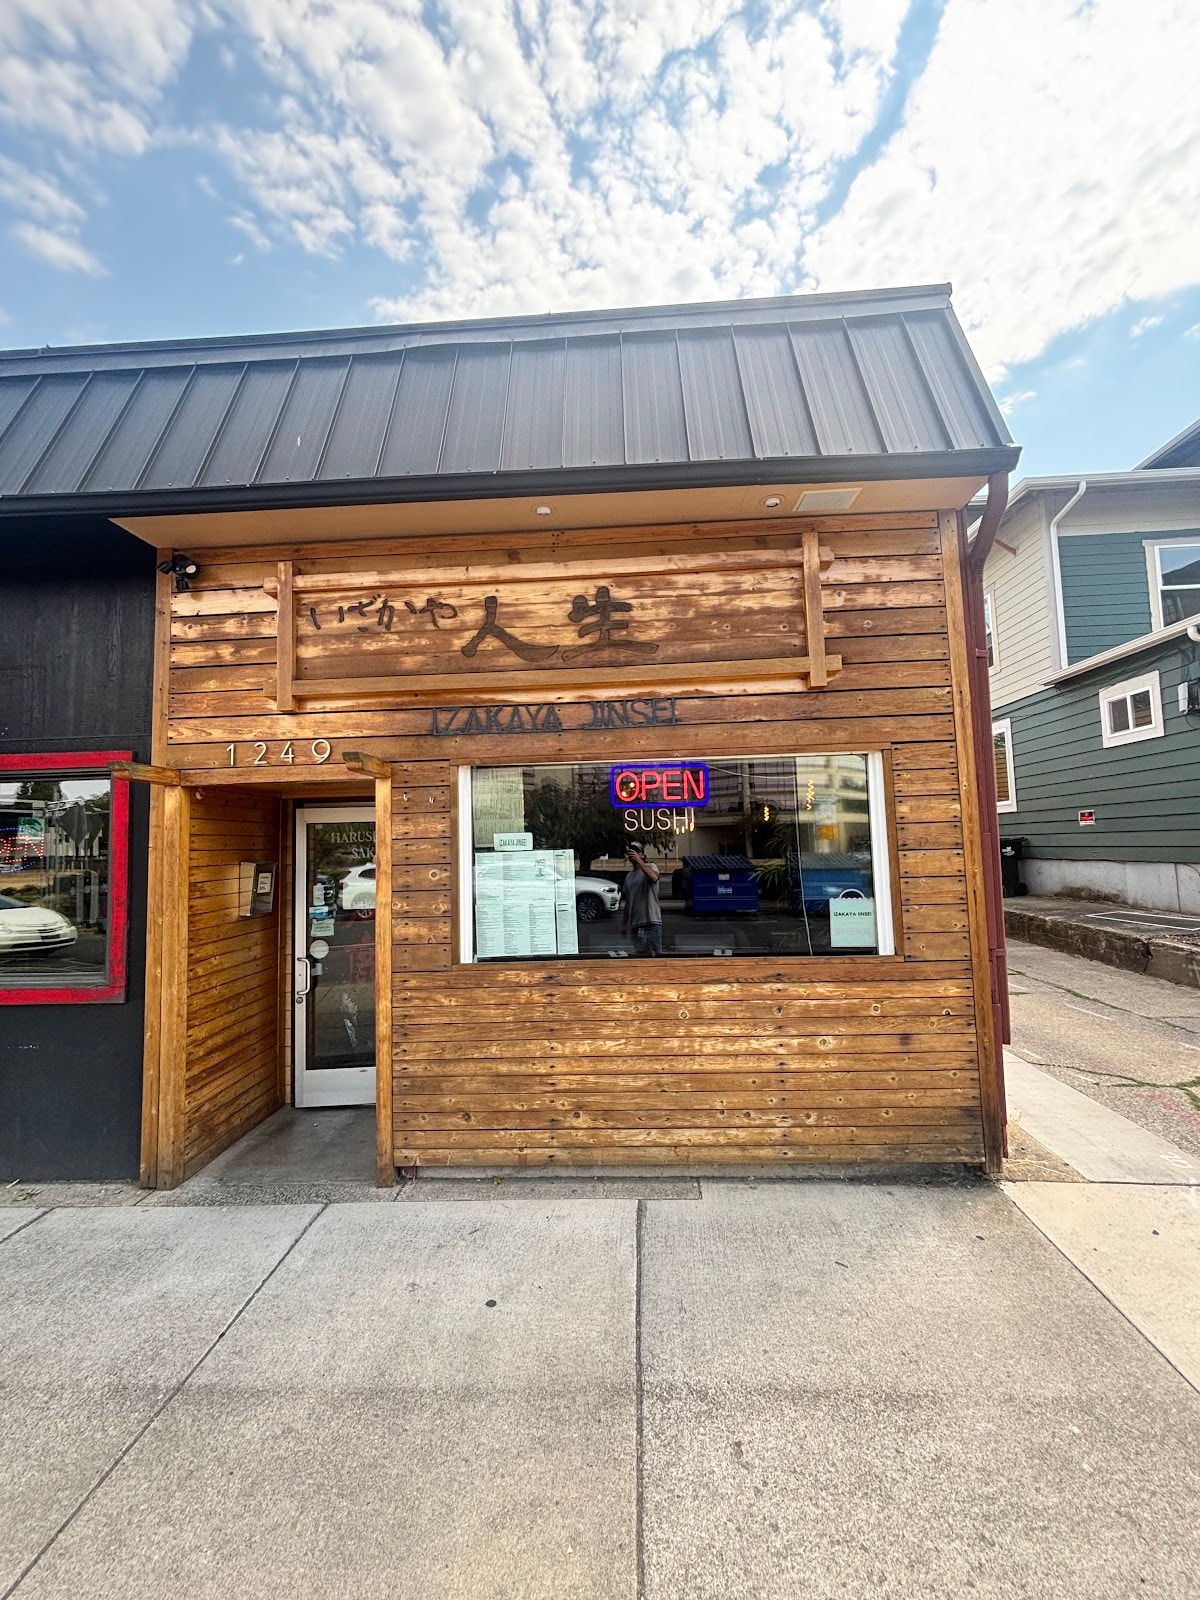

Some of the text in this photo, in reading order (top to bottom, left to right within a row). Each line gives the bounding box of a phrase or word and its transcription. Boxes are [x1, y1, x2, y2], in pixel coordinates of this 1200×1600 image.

[432, 696, 678, 736] IZAKAYA JINSEI
[226, 739, 332, 767] 1249
[615, 769, 705, 803] OPEN
[624, 807, 695, 832] SUSHI
